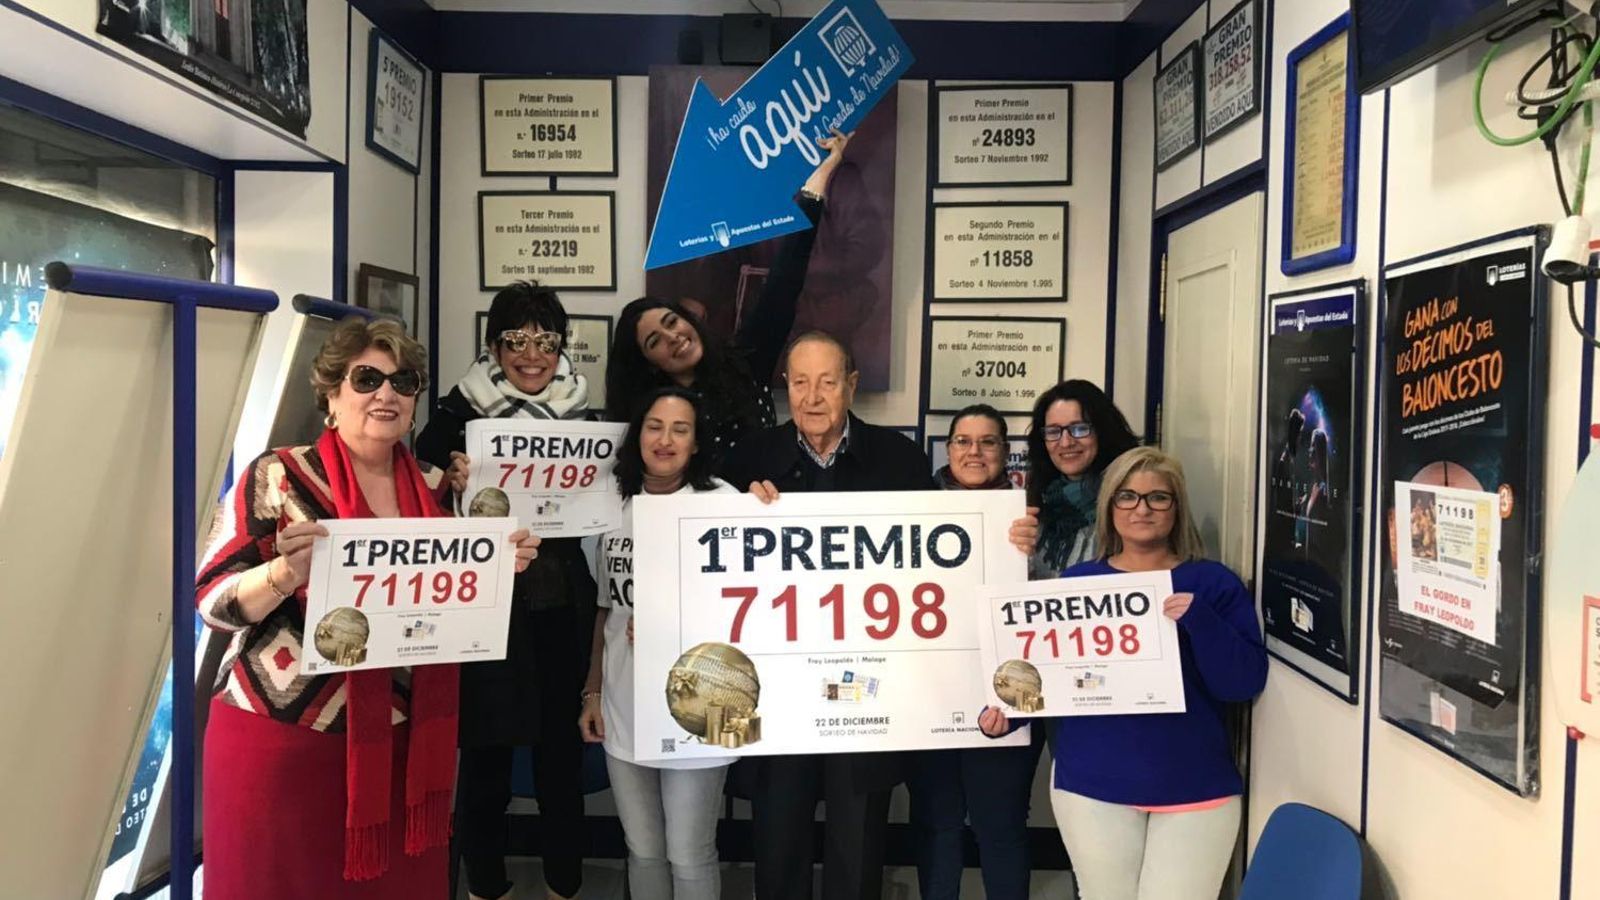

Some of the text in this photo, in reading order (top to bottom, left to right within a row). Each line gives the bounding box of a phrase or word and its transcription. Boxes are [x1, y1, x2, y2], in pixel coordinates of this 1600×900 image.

[1219, 9, 1246, 44] GRAN
[1214, 25, 1251, 68] PREMIO
[390, 61, 417, 95] PREMIO
[1167, 56, 1188, 85] GRAN
[1163, 70, 1192, 100] PREMIO
[385, 81, 414, 121] 19152
[519, 93, 574, 103] Primer Premio
[850, 86, 866, 106] de
[974, 98, 1029, 108] Primer Premio
[494, 108, 599, 118] en esta Administración en el
[739, 50, 831, 170] aquí
[960, 114, 976, 122] esta
[978, 112, 1034, 121] Administración
[1047, 112, 1055, 120] el
[1207, 103, 1235, 132] VENDIDO
[530, 124, 577, 142] 16954
[982, 128, 1036, 147] 24893
[512, 149, 582, 160] Sorteo 17 julio 1982
[954, 155, 979, 164] Sorteo
[987, 154, 1028, 163] Noviembre
[1030, 154, 1049, 163] 1992
[521, 210, 574, 219] Tercer Premio
[495, 224, 600, 234] en esta Administración en el
[709, 235, 715, 243] y
[731, 223, 761, 236] Apuestas
[762, 220, 772, 229] del
[773, 215, 795, 226] Estado
[969, 220, 1035, 230] Segundo Premio
[978, 232, 1035, 241] Administración
[1052, 232, 1060, 240] el
[532, 240, 578, 257] 23219
[982, 250, 1033, 267] 11858
[502, 264, 525, 274] Sorteo
[537, 265, 576, 275] septiembre
[577, 264, 595, 274] 1982
[949, 280, 975, 288] Sorteo
[987, 279, 1028, 288] Noviembre
[1404, 297, 1458, 339] GANA CON
[968, 330, 1024, 340] Primer Premio
[951, 342, 968, 351] esta
[971, 342, 1028, 352] Administración
[1045, 344, 1053, 352] el
[1396, 315, 1494, 375] LOS DÉCIMOS DEL
[975, 361, 1027, 378] 37004
[952, 388, 977, 397] Sorteo
[981, 389, 986, 397] 8
[989, 389, 1011, 398] Junio
[1402, 350, 1502, 418] BALONCESTO
[512, 436, 613, 459] PREMIO
[498, 463, 597, 489] 71198
[1438, 504, 1474, 520] 71198
[342, 537, 495, 567] 1er PREMIO
[697, 523, 972, 573] 1er PREMIO
[606, 557, 633, 573] VEN
[353, 570, 478, 608] 71198
[1421, 585, 1471, 610] EL GORDO EN
[721, 582, 948, 643] 71198
[1024, 592, 1151, 623] PREMIO
[1414, 601, 1435, 615] FRAY
[1437, 607, 1474, 631] LEOPOLDO
[1015, 624, 1141, 660] 71198
[808, 657, 822, 665] Fray
[824, 656, 854, 665] Leopoldo
[815, 716, 891, 727] 22 DE DICIEMBRE
[819, 729, 846, 737] SORTEO
